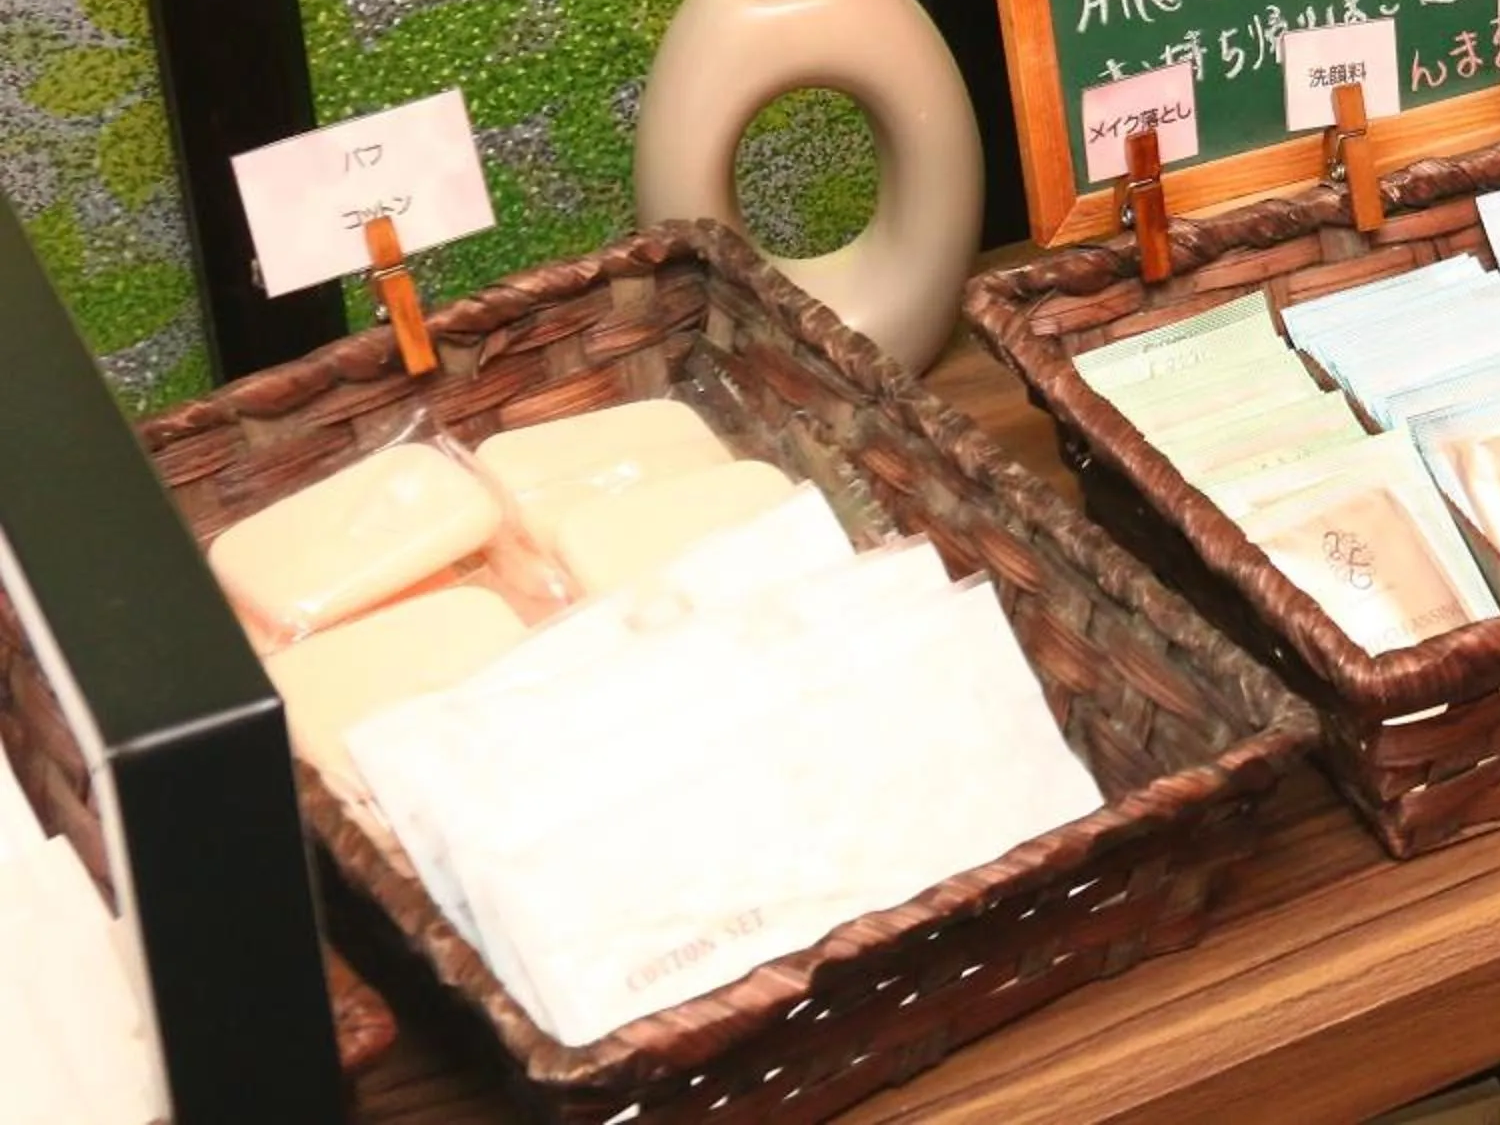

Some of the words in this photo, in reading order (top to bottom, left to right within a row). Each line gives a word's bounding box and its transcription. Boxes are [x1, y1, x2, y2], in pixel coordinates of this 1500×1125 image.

[1308, 60, 1367, 88] 洗顔料
[1087, 100, 1192, 143] メイク落とし
